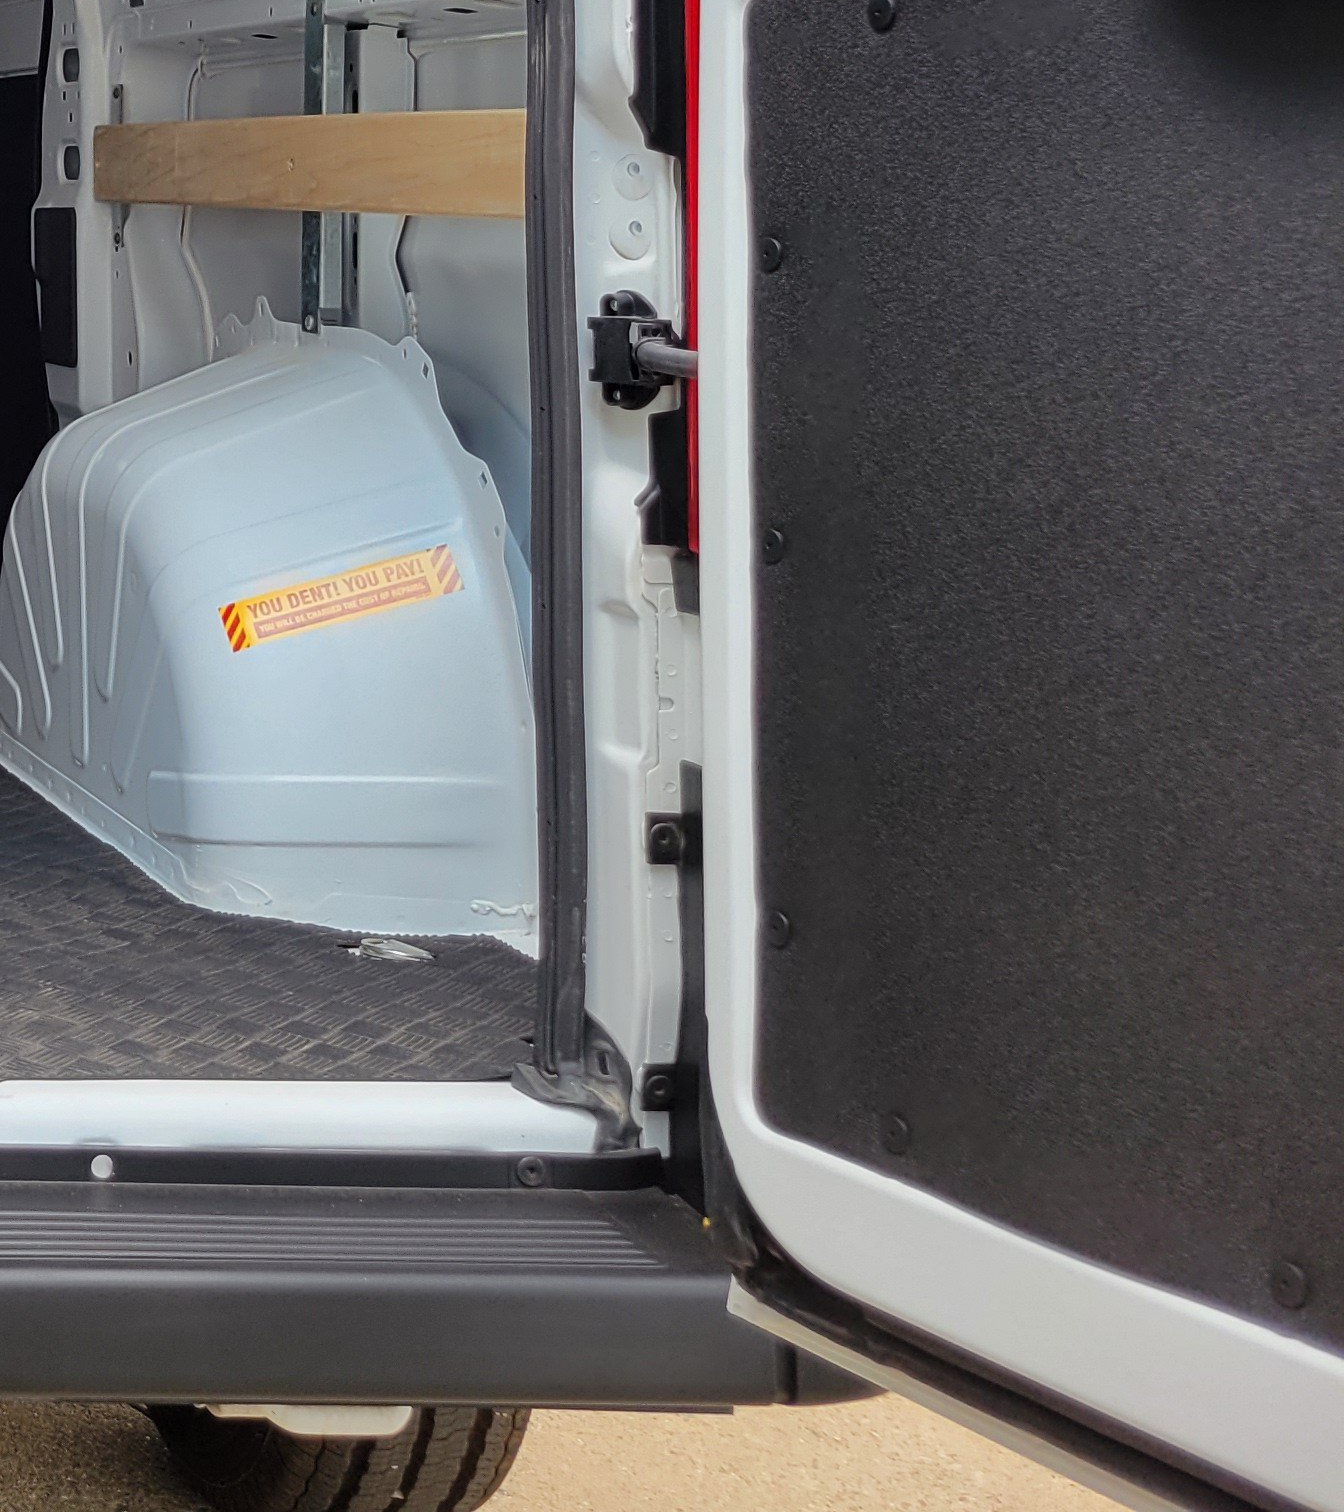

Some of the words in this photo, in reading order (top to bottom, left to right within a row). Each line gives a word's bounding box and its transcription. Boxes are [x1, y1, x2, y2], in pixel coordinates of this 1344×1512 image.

[247, 598, 284, 620] YOU
[286, 580, 341, 609] DENT!
[341, 570, 380, 593] YOU
[382, 559, 425, 582] PAY!
[259, 622, 275, 633] YOU
